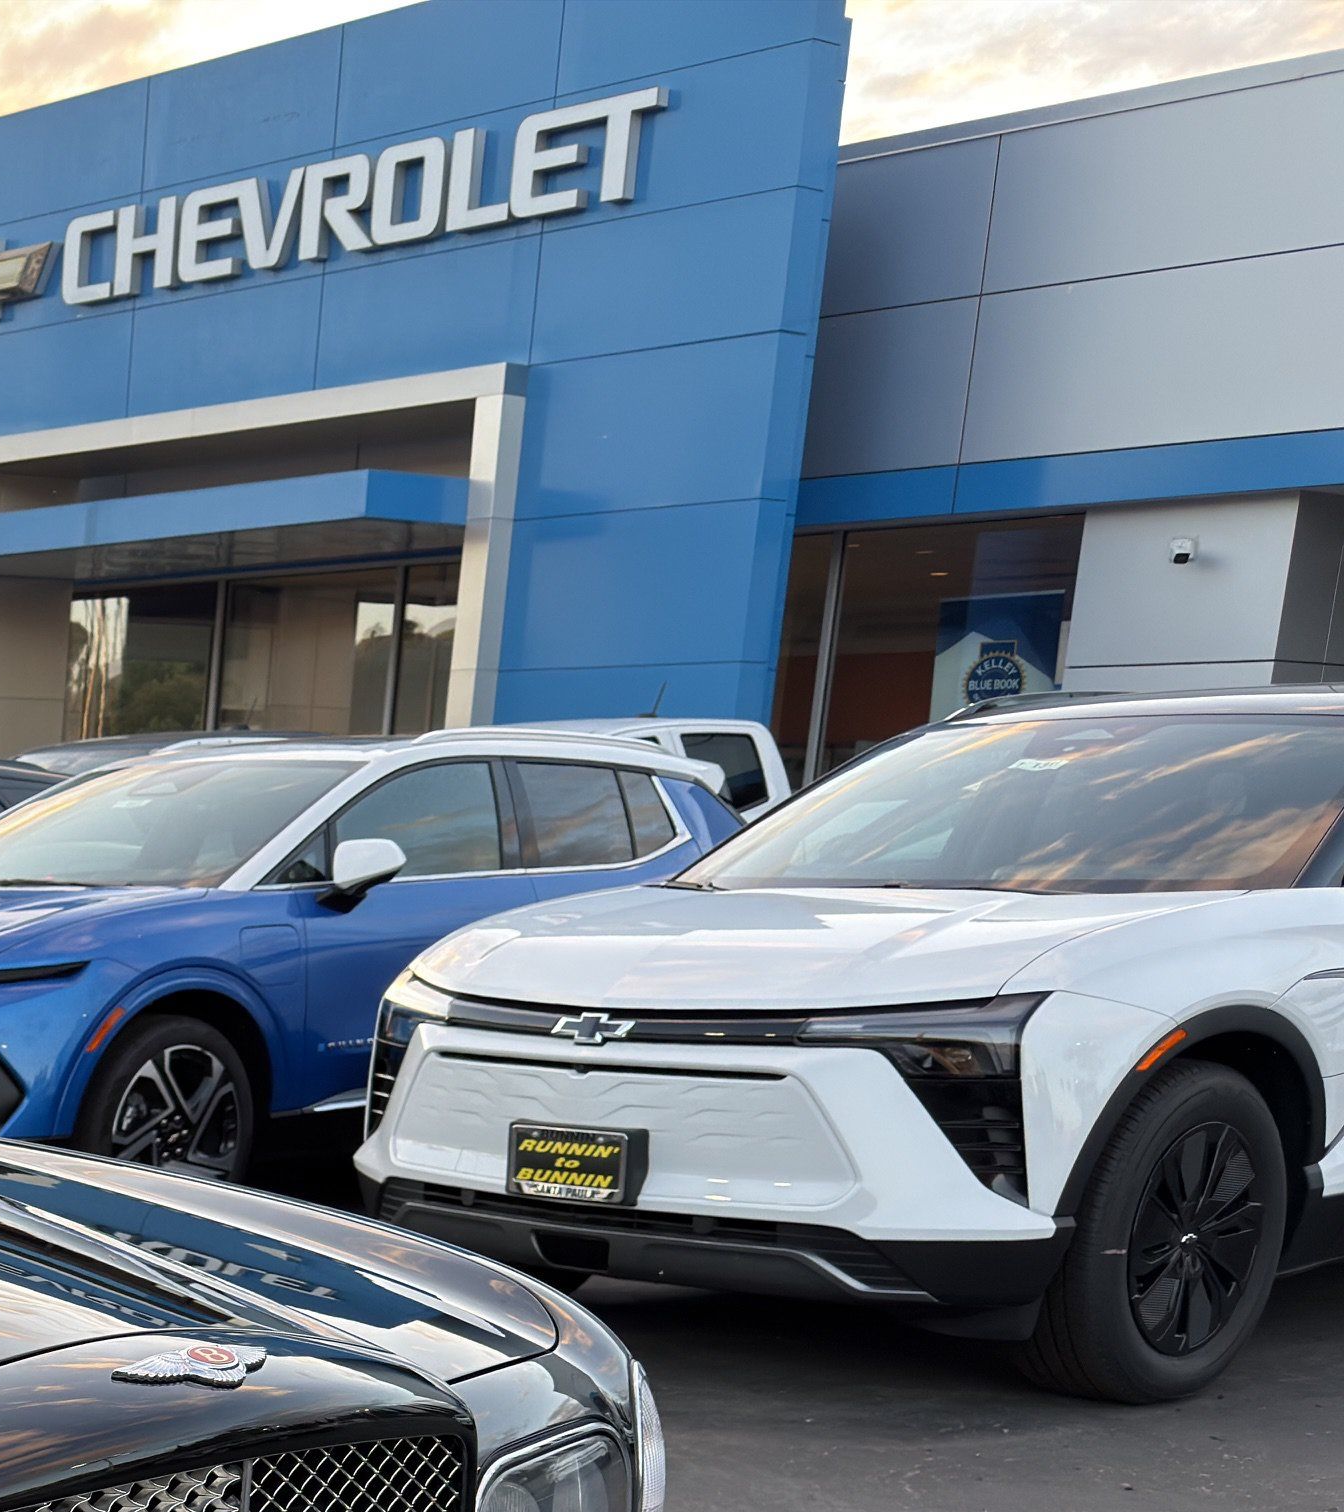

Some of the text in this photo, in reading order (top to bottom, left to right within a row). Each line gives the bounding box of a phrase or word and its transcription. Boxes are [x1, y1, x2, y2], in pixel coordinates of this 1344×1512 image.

[61, 86, 671, 306] CHEVROLET
[977, 659, 1017, 675] KELLEY
[969, 679, 1018, 690] BLUE BOOK
[518, 1138, 621, 1158] RUNNIN'
[554, 1156, 580, 1169] to
[516, 1167, 613, 1188] BUNNIN
